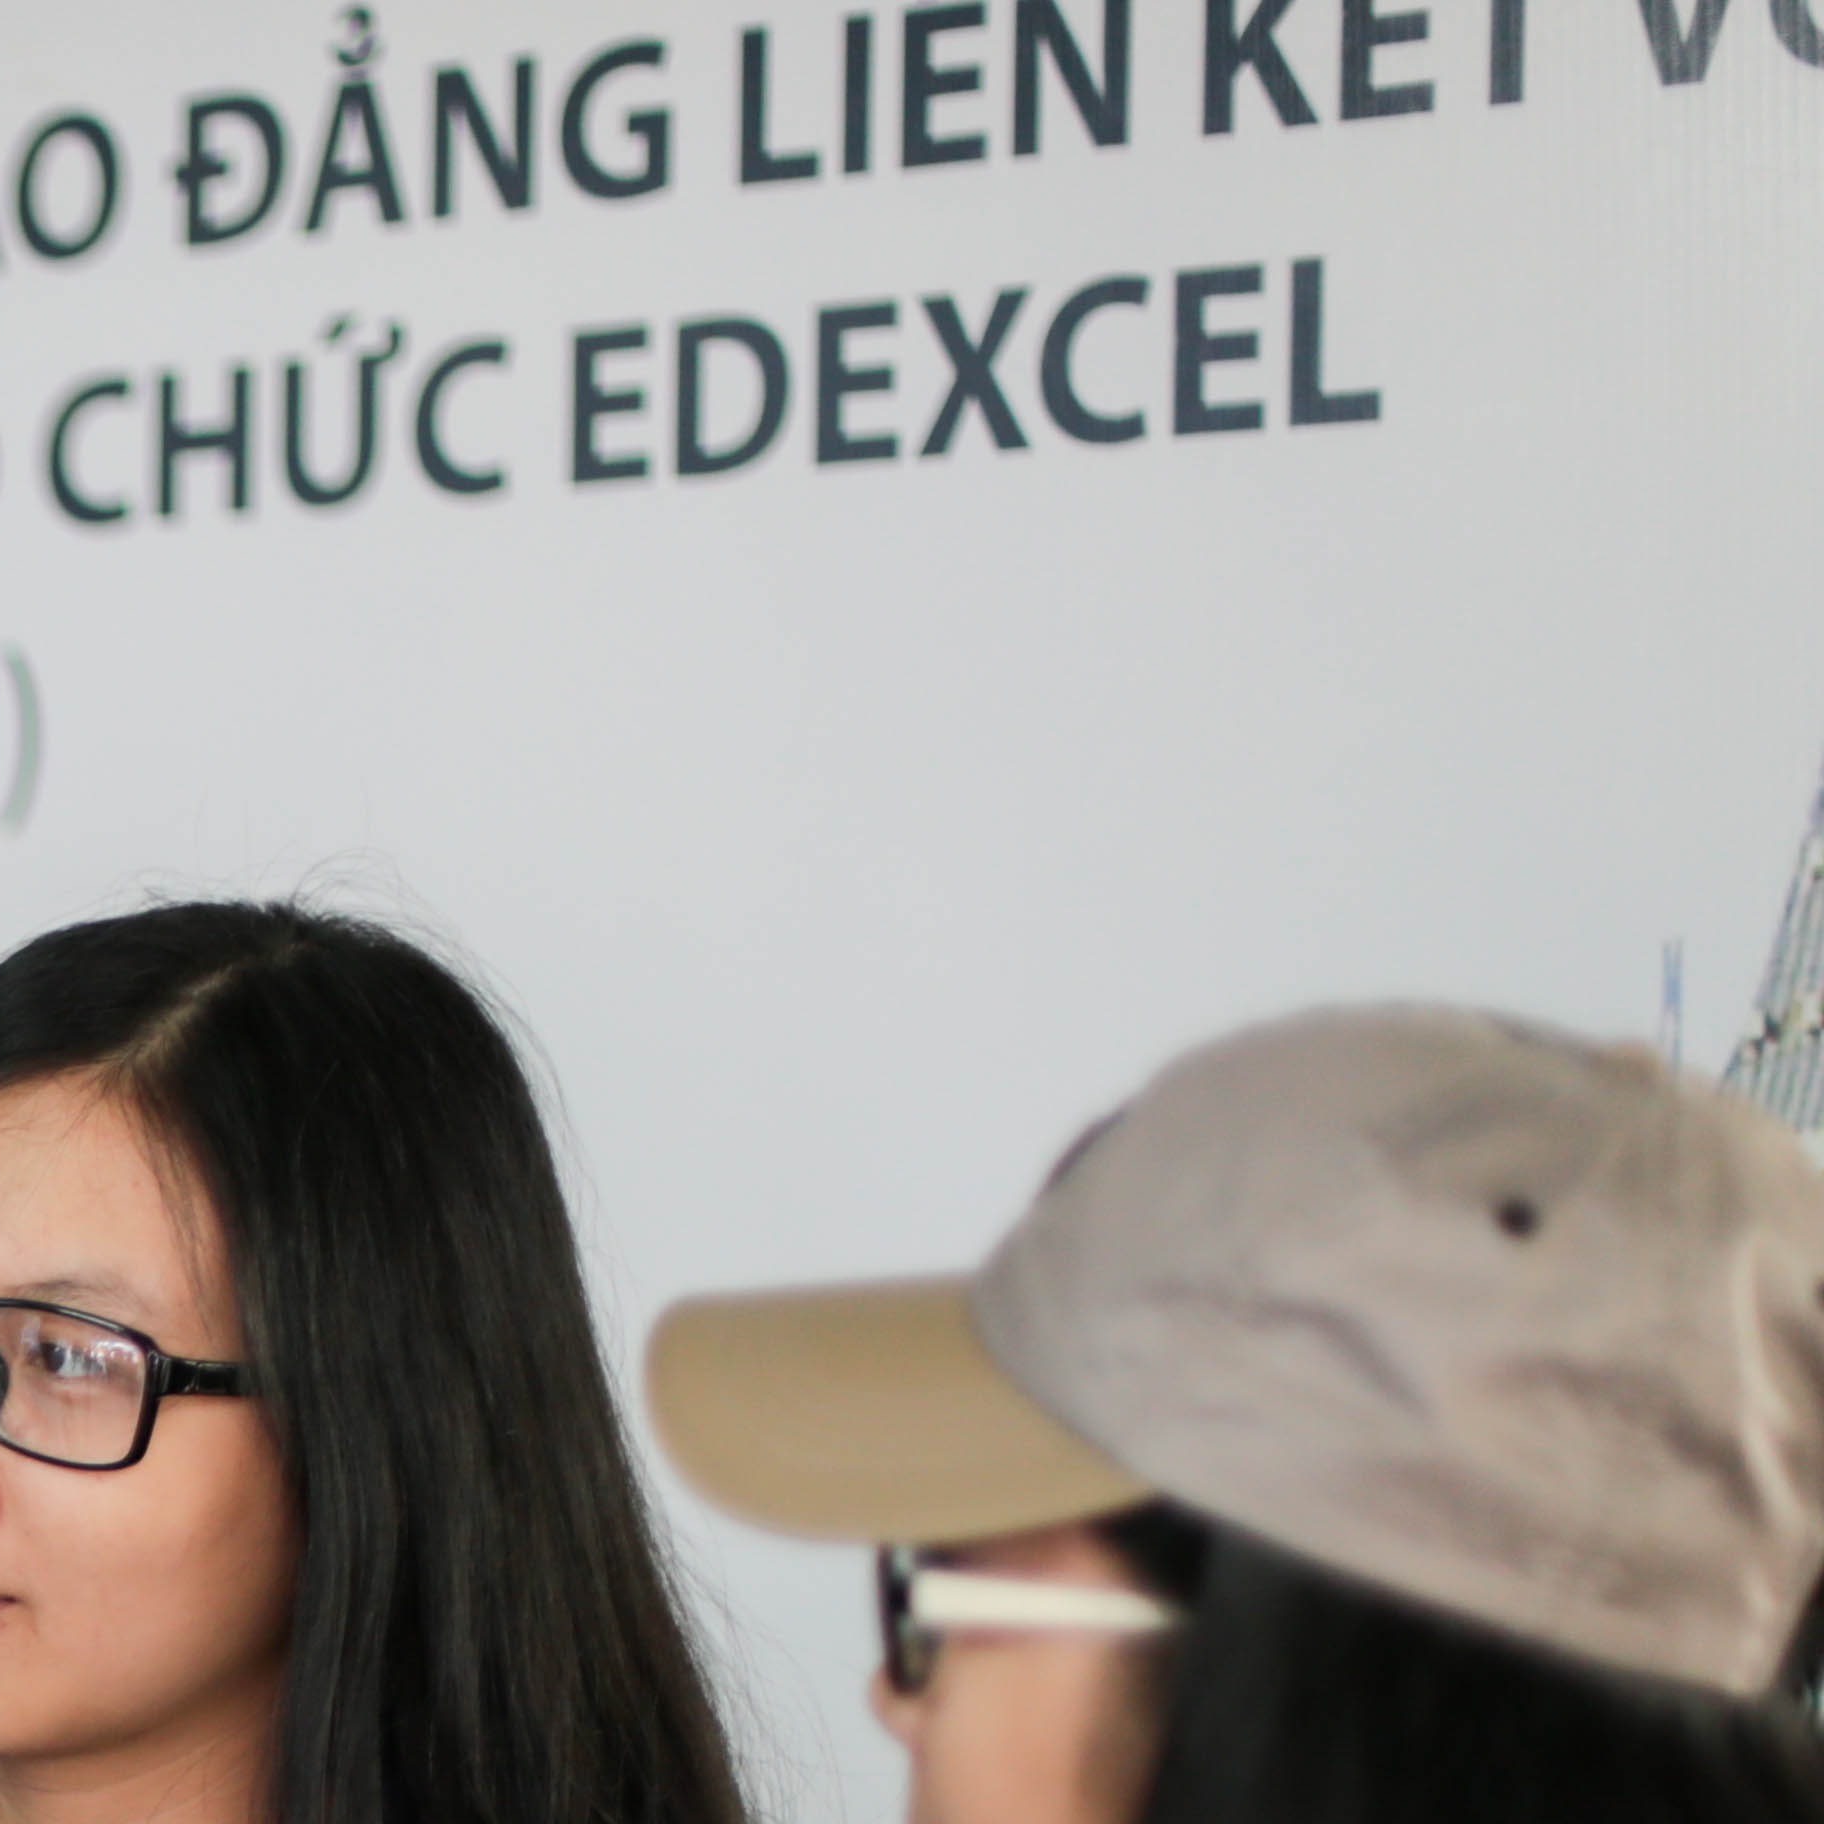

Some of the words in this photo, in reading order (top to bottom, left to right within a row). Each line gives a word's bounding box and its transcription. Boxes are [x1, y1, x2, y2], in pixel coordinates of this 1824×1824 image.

[172, 8, 673, 252] ĐẲNG
[46, 318, 510, 528] CHỨC
[566, 257, 1384, 486] EDEXCEL
